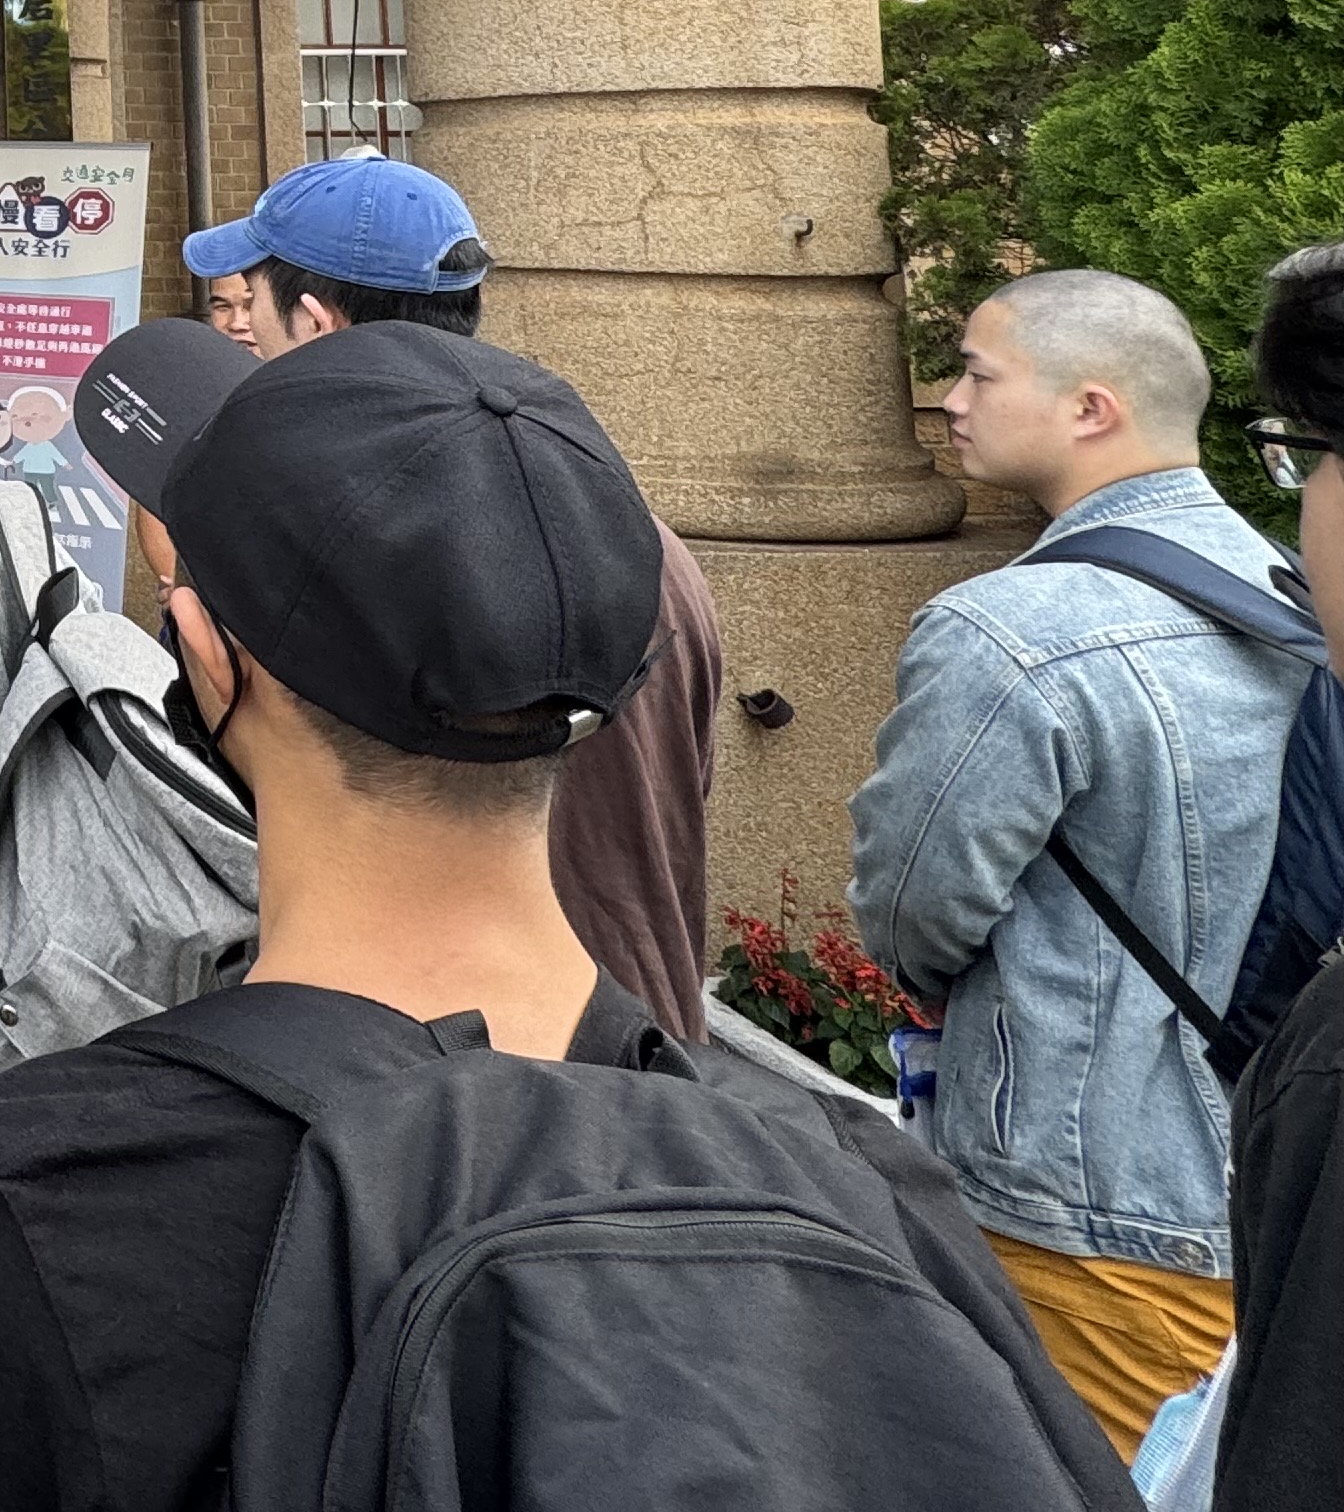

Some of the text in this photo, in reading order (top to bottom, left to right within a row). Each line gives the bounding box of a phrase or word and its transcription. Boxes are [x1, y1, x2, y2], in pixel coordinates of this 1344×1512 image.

[61, 164, 135, 185] 交通安全月
